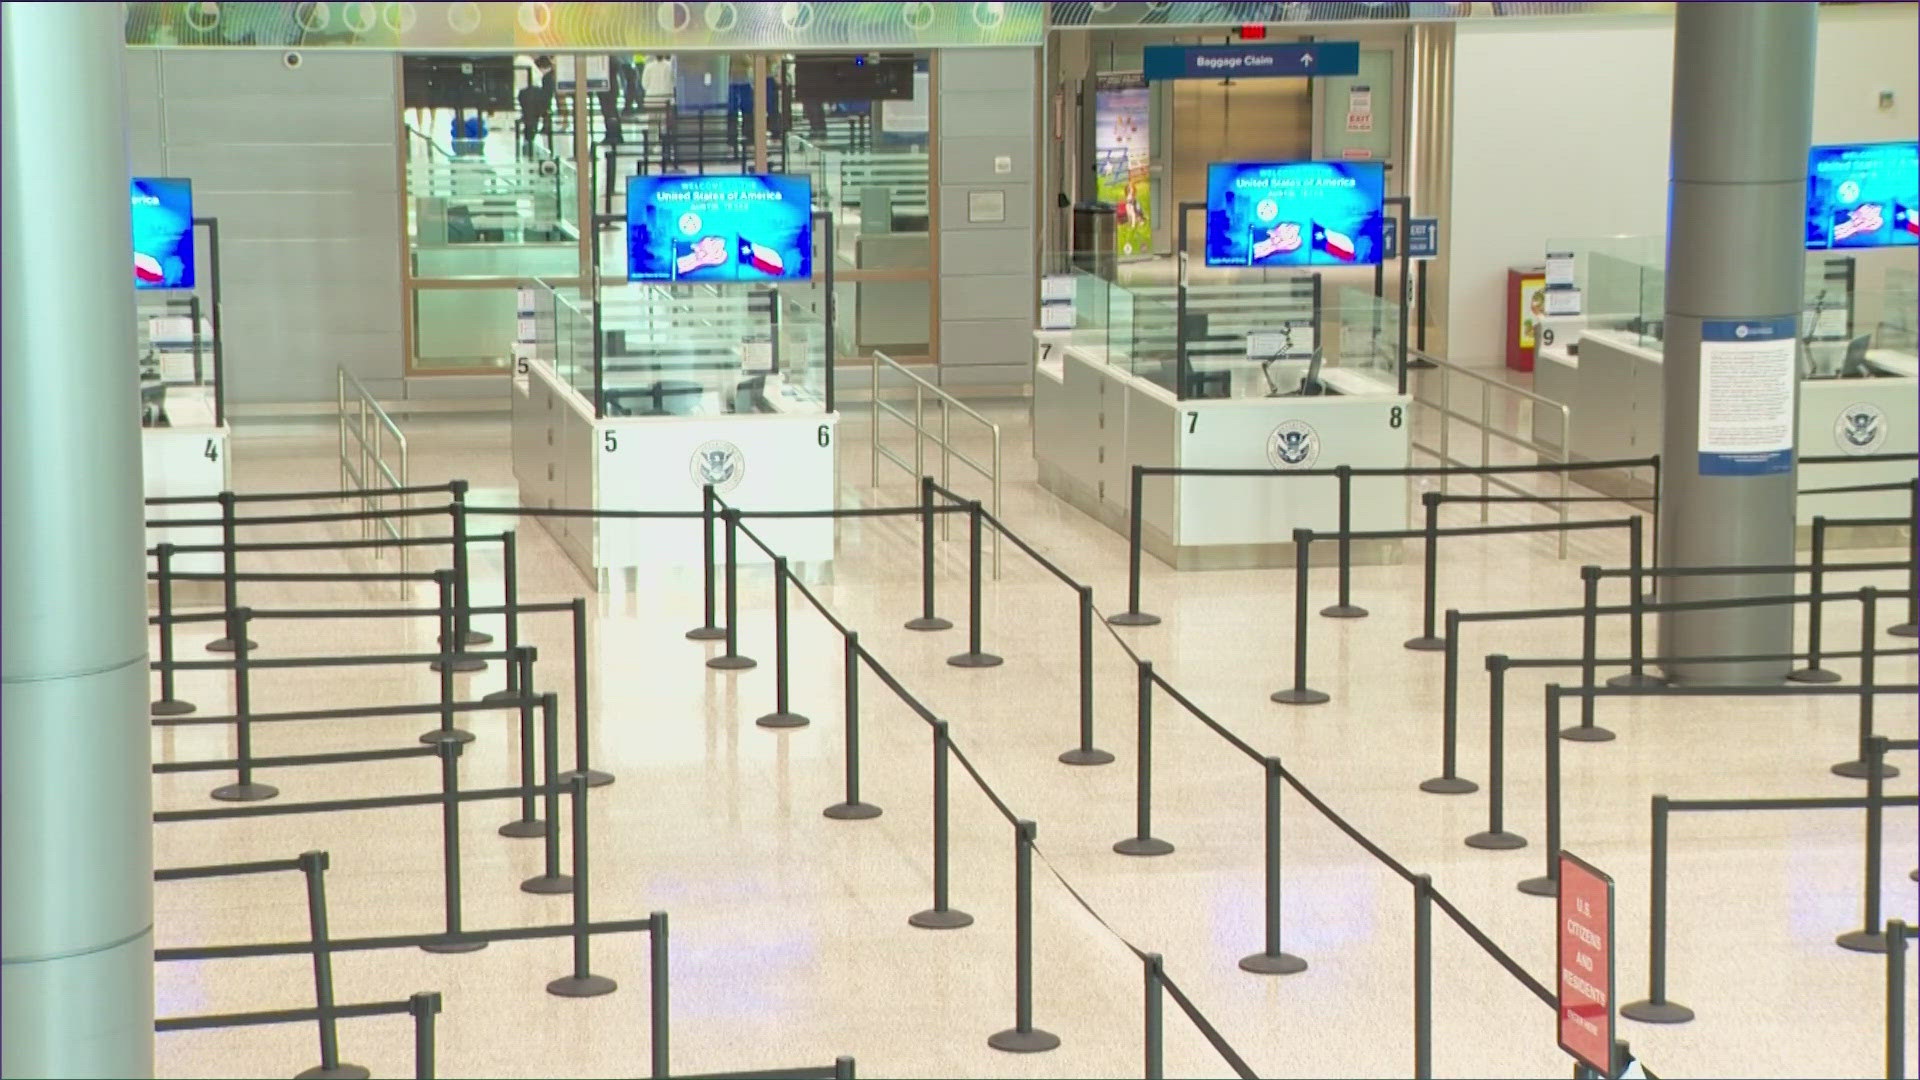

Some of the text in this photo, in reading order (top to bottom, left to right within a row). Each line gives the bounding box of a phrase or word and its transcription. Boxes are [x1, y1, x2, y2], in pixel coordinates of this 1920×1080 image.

[1196, 55, 1273, 68] Baggage Claim
[1236, 178, 1269, 188] United
[1316, 177, 1356, 188] America
[656, 191, 782, 201] United States of America
[1543, 329, 1554, 346] 9
[1040, 343, 1053, 360] 7
[518, 357, 529, 374] 5
[1187, 412, 1199, 434] 7
[1390, 406, 1402, 429] 8
[604, 430, 617, 452] 5
[817, 424, 830, 447] 6
[204, 438, 218, 462] 4
[1568, 920, 1602, 950] CITIZENS
[1576, 952, 1593, 972] AND
[1563, 968, 1606, 1007] RESIDENTS
